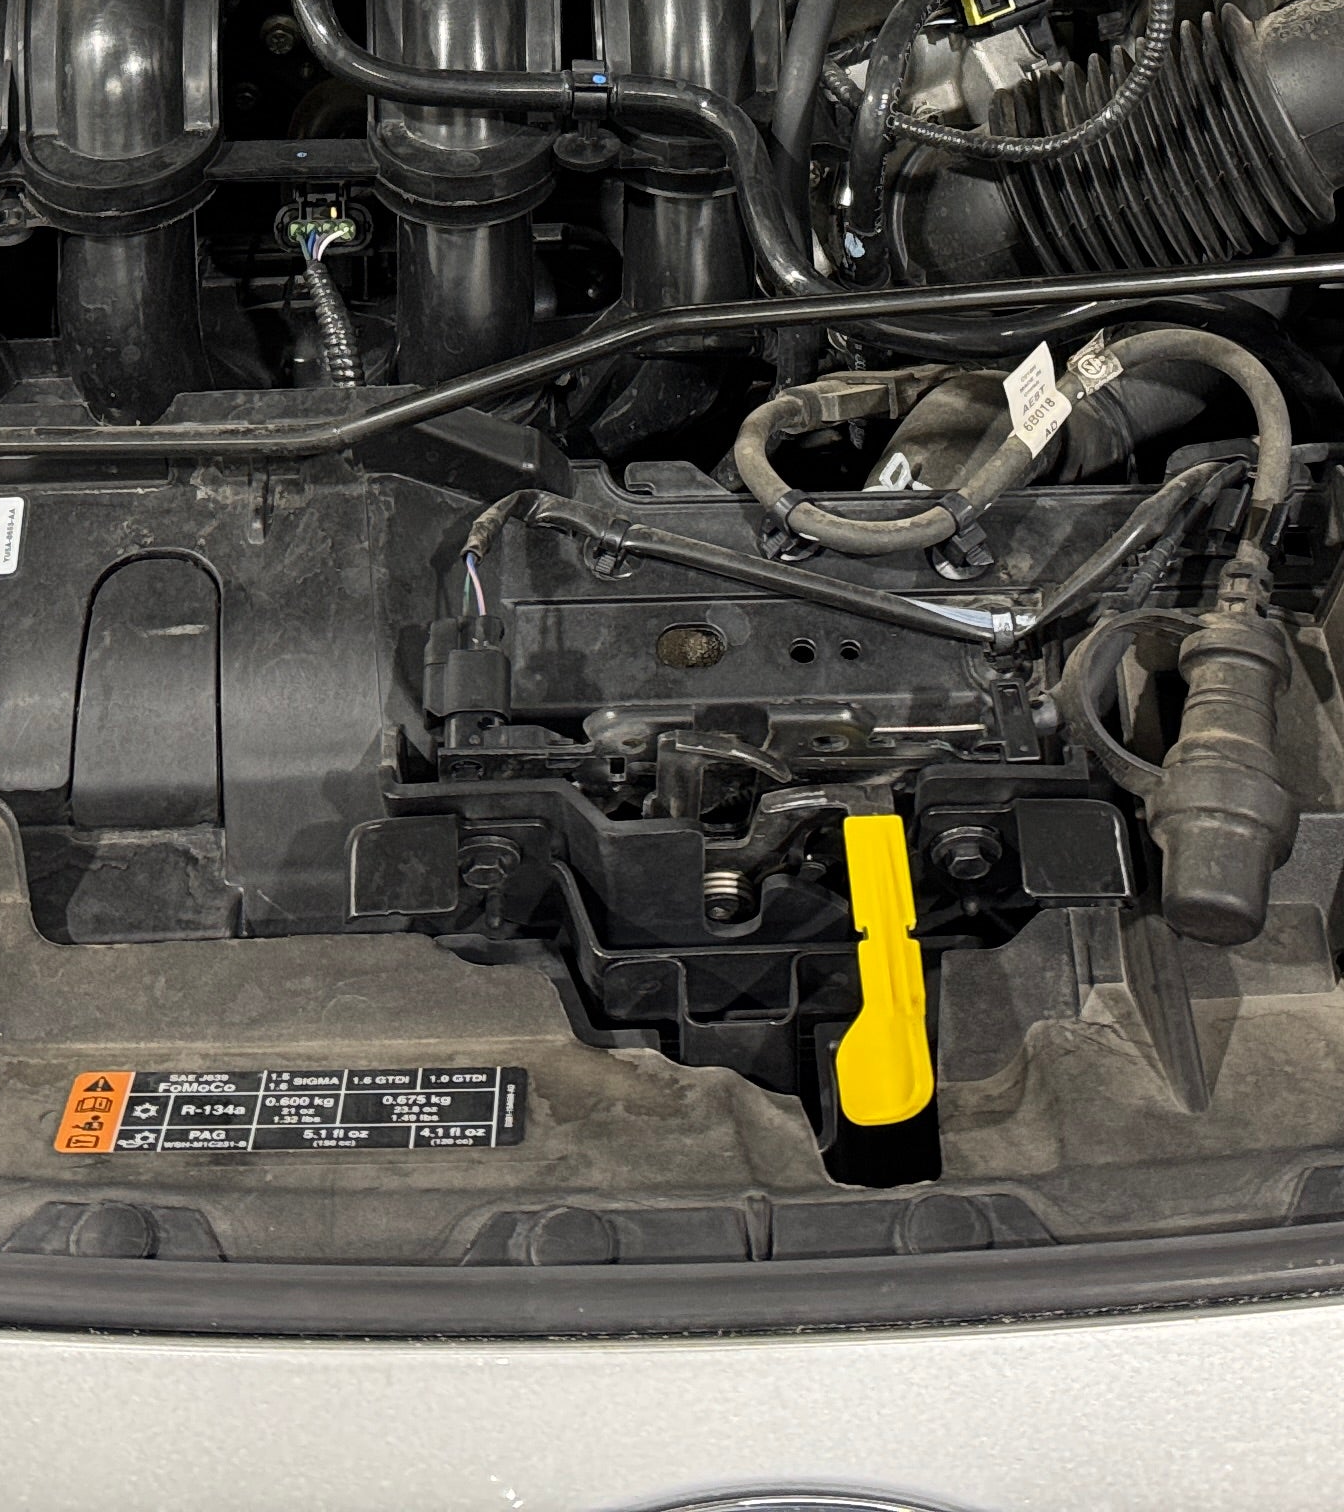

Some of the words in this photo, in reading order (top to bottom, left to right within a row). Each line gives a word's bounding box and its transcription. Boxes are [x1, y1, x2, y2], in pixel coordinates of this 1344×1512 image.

[1023, 398, 1056, 432] 6B018
[170, 1074, 196, 1082] SAE
[293, 1077, 340, 1086] SIGMA
[353, 1076, 373, 1084] 1.6
[376, 1076, 410, 1084] GTDI
[430, 1075, 450, 1083] 1.0
[452, 1074, 487, 1083] GTDI
[158, 1082, 236, 1092] FoMoCo
[265, 1097, 310, 1106] 0.600
[314, 1097, 334, 1108] kg
[382, 1095, 426, 1105] 0.675
[431, 1095, 451, 1106] kg
[180, 1105, 246, 1116] R-134a
[419, 1114, 439, 1122] lbs
[188, 1130, 226, 1140] PAG
[303, 1130, 331, 1139] 5.1
[333, 1130, 345, 1138] fl
[420, 1128, 444, 1137] 4.1
[449, 1128, 461, 1137] fl
[465, 1129, 486, 1137] oz
